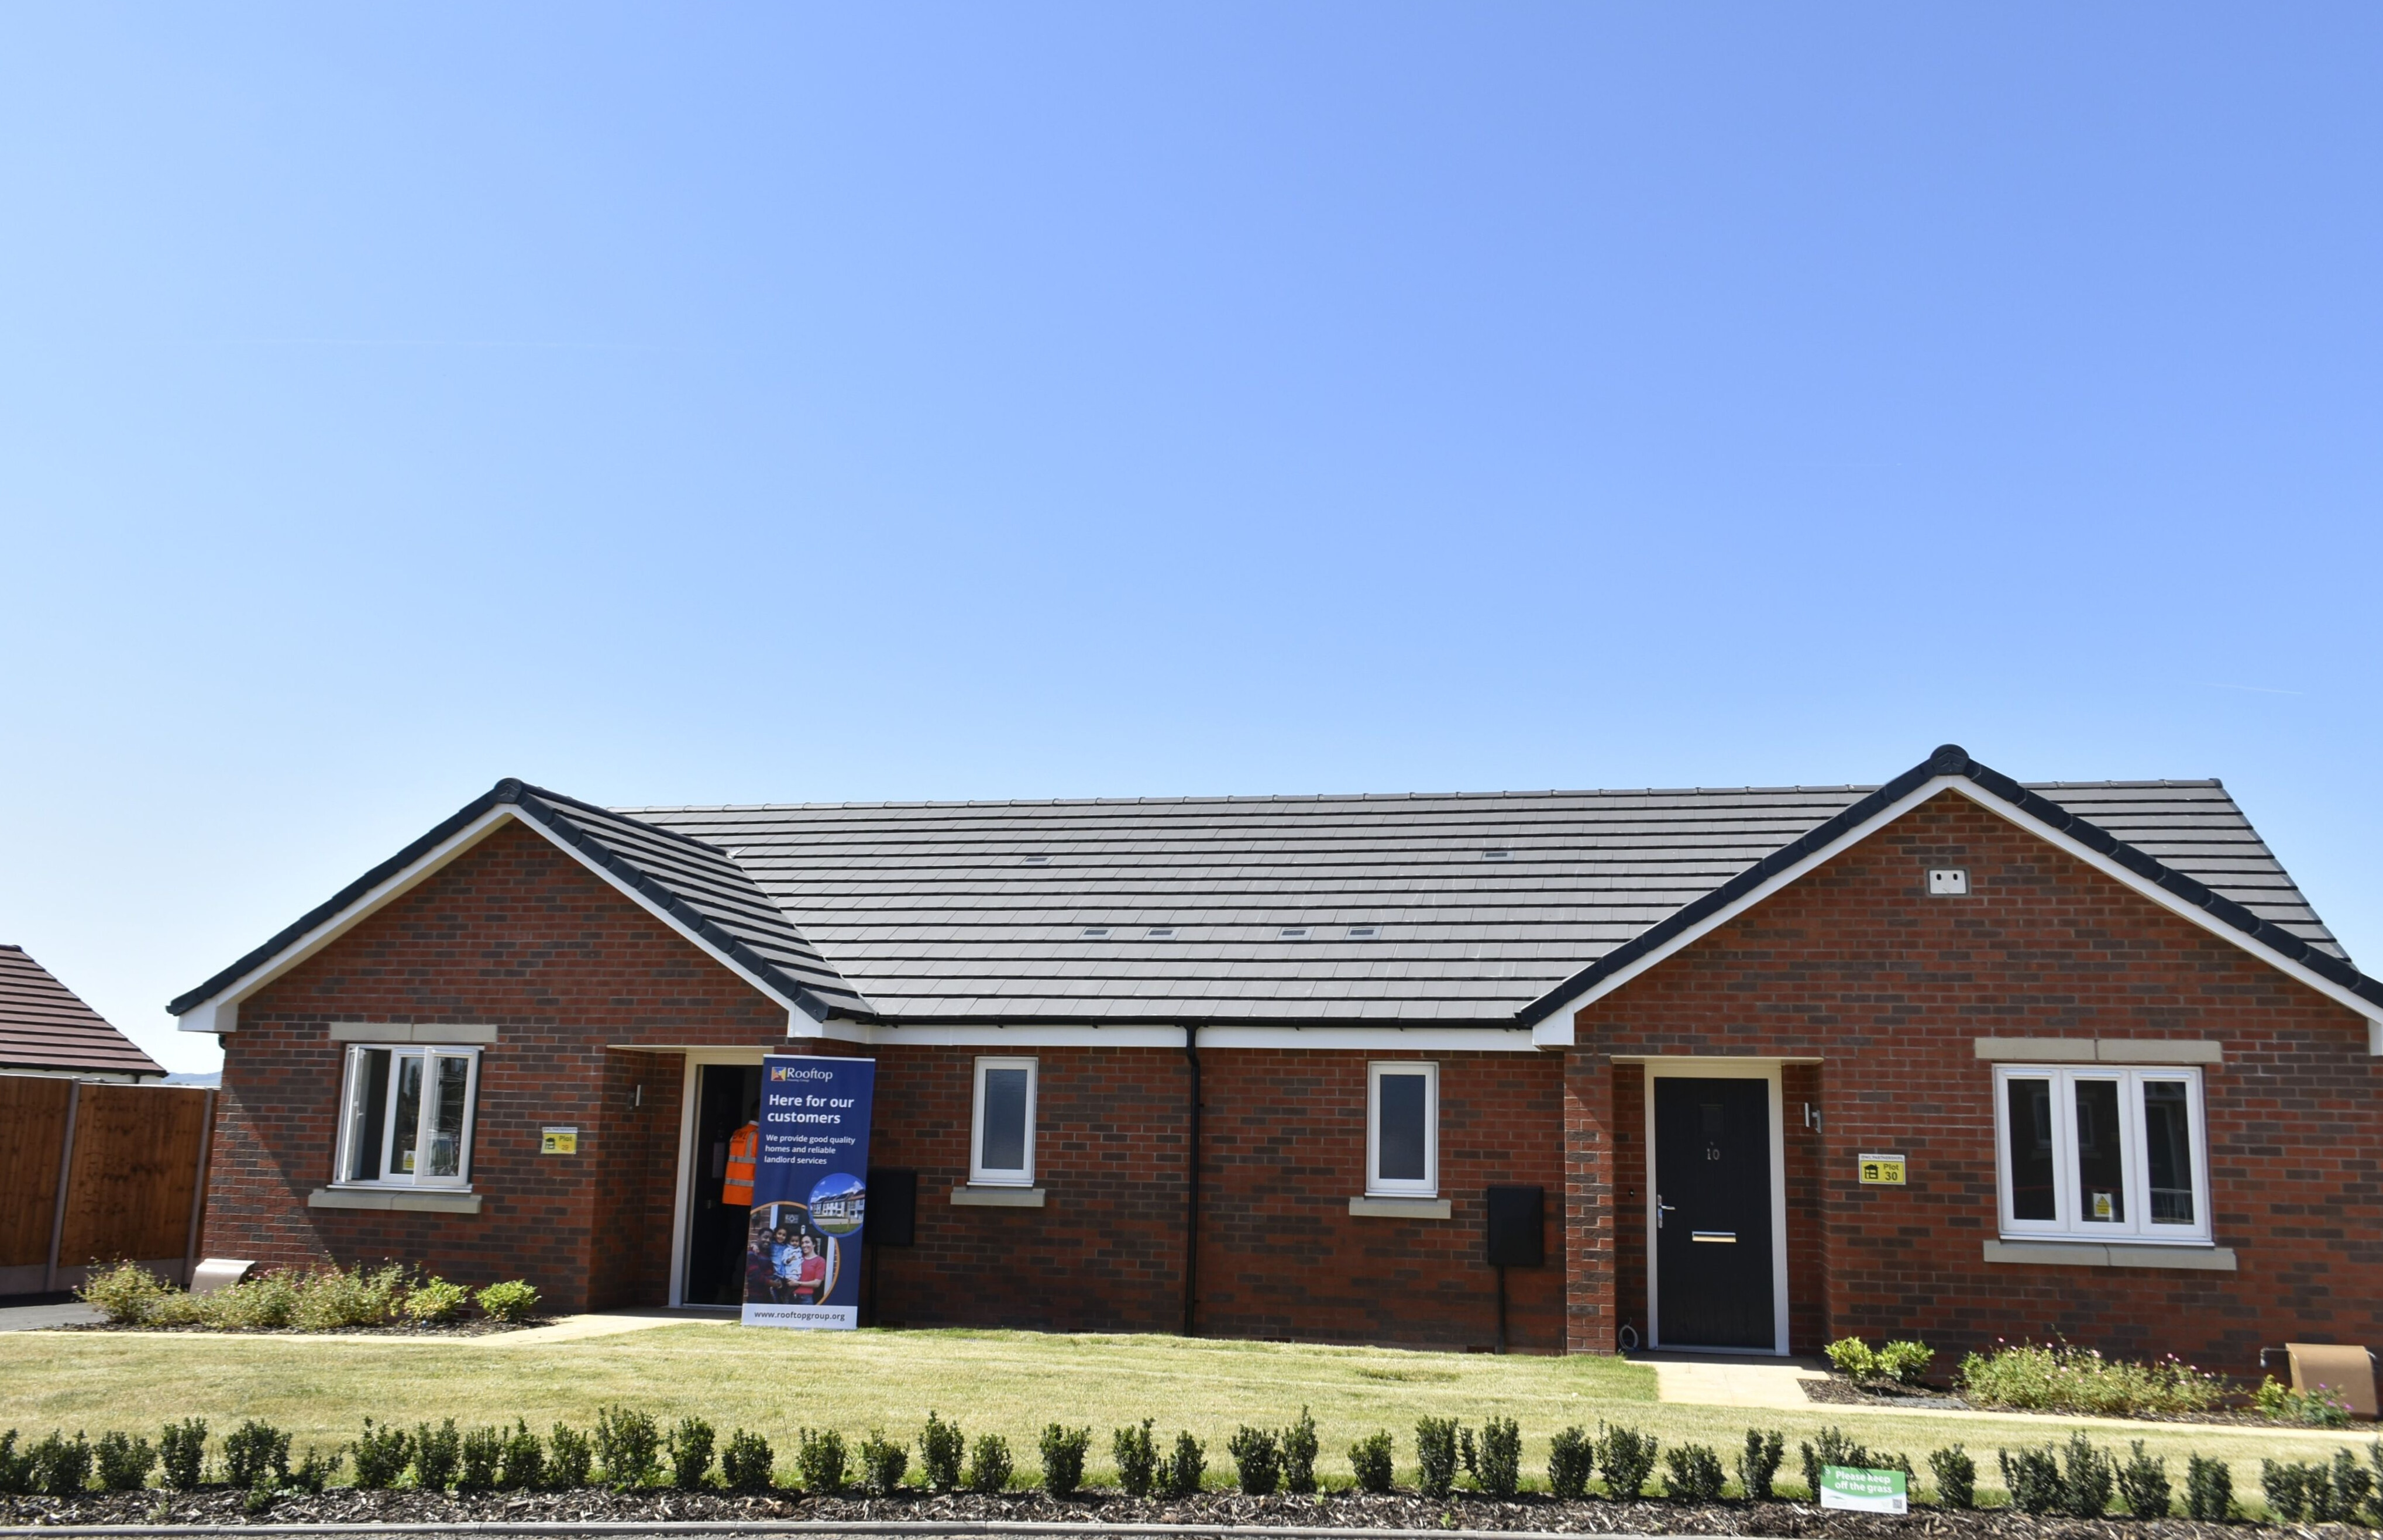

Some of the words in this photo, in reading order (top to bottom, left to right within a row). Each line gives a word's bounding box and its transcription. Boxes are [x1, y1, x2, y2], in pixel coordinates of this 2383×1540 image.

[787, 1067, 833, 1082] Rooftop
[769, 1094, 803, 1106] Here
[806, 1095, 827, 1107] for
[830, 1098, 854, 1108] our
[767, 1112, 841, 1124] customers
[779, 1135, 808, 1143] provide
[809, 1136, 828, 1144] good
[830, 1136, 856, 1145] quality
[1707, 1148, 1720, 1160] 10
[1885, 1172, 1898, 1181] 30
[754, 1311, 845, 1321] www.rooftopgroup.org
[1835, 1470, 1866, 1481] Please
[1867, 1473, 1891, 1484] keep
[1835, 1480, 1848, 1489] off
[1849, 1482, 1866, 1491] the
[1867, 1485, 1893, 1494] grass
